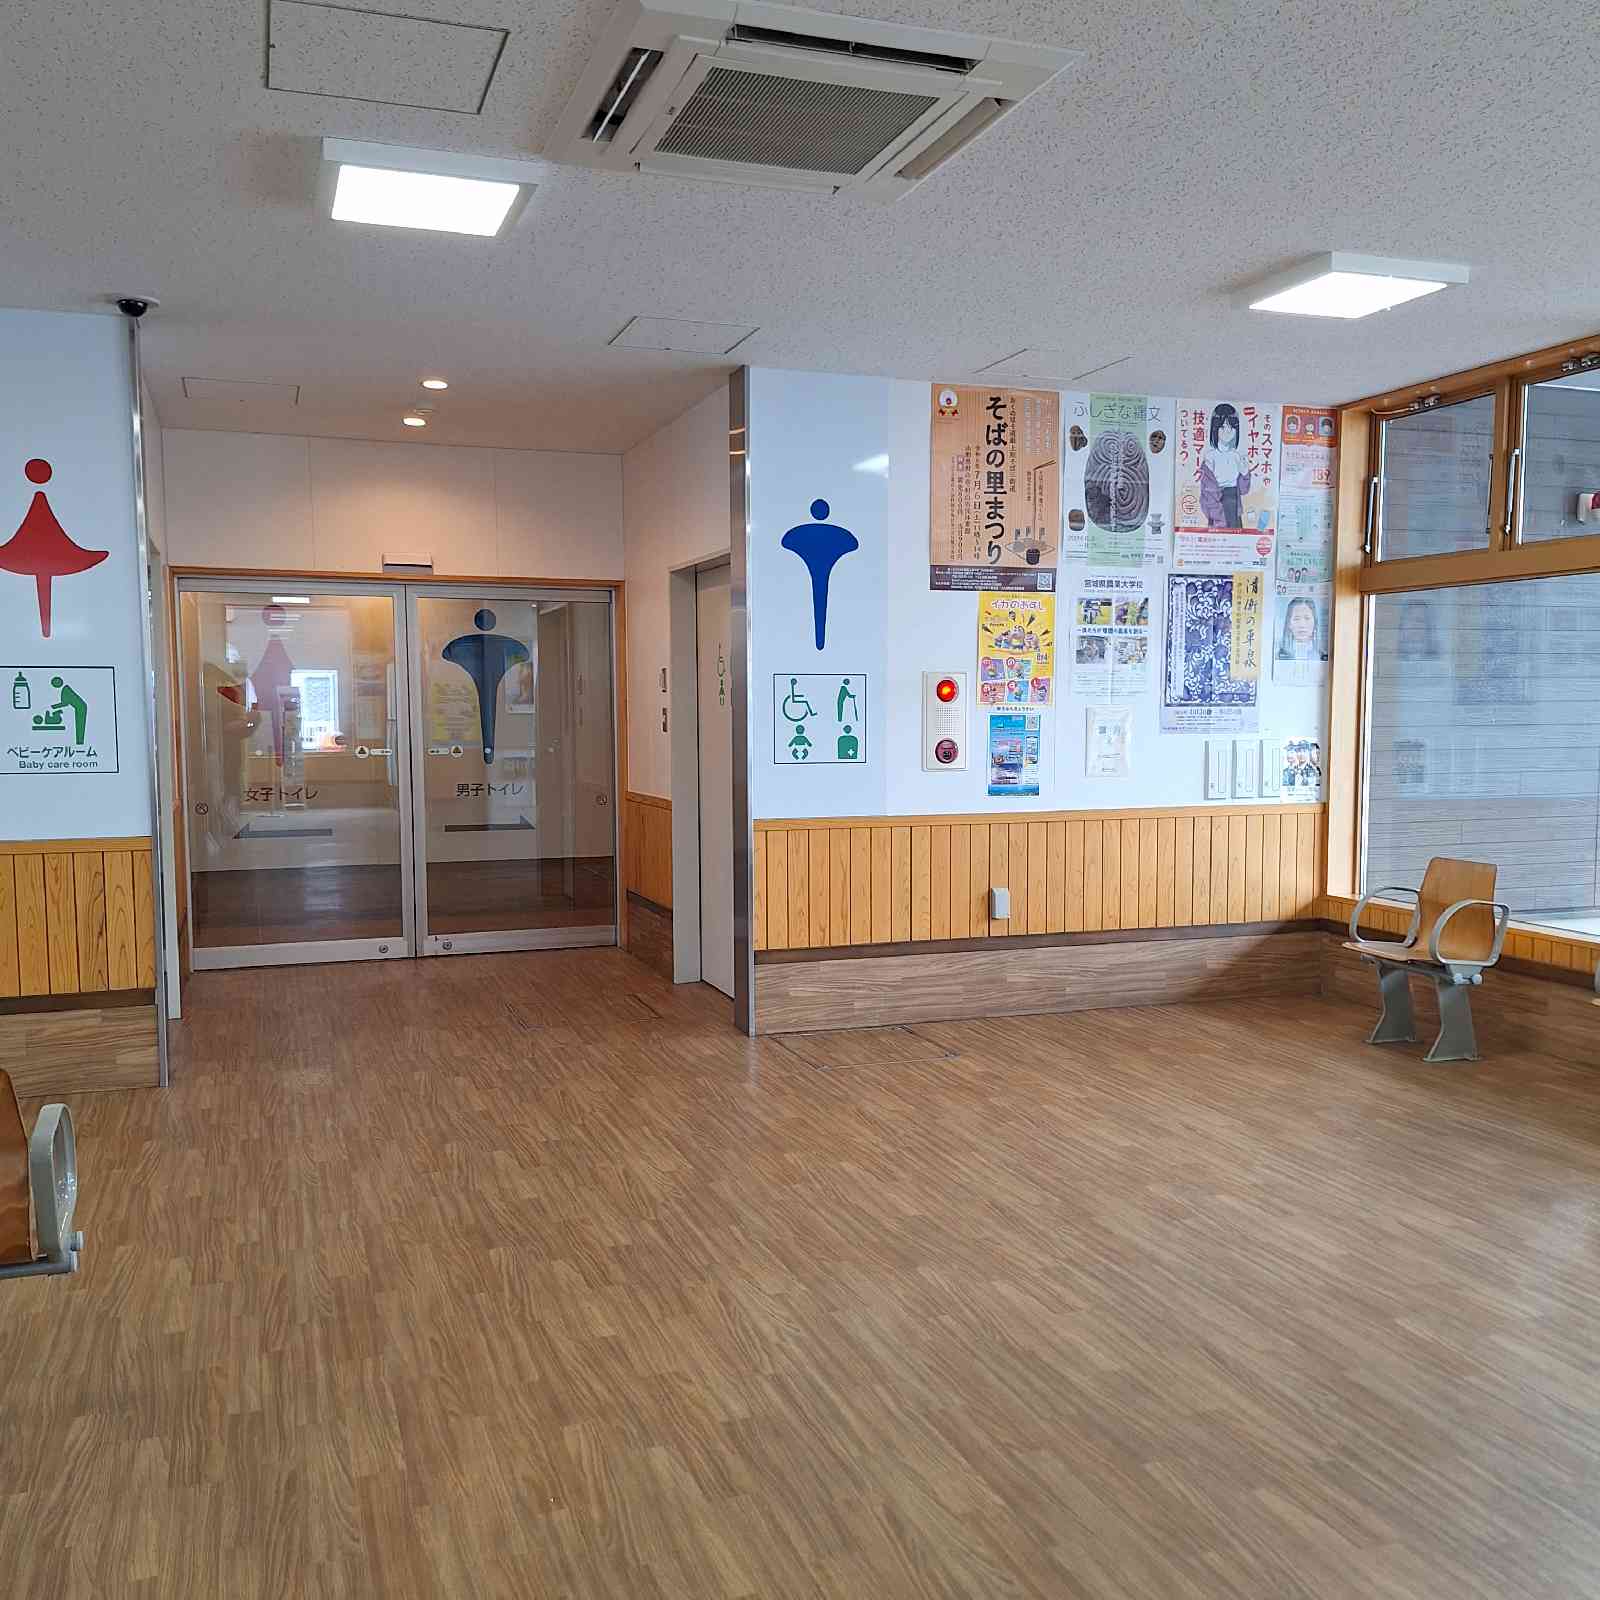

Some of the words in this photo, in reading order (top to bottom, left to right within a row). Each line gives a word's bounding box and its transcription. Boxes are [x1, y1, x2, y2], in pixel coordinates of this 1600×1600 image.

[1192, 408, 1205, 483] 技適マーク
[1261, 414, 1273, 488] そのスマホや
[985, 396, 1008, 565] そばの里まつり
[7, 745, 98, 759] ベビーケアルーム
[19, 760, 45, 770] Baby
[47, 761, 70, 769] care
[72, 760, 98, 769] room
[245, 787, 319, 802] 女子トイレ
[456, 783, 524, 797] 男子トイレ
